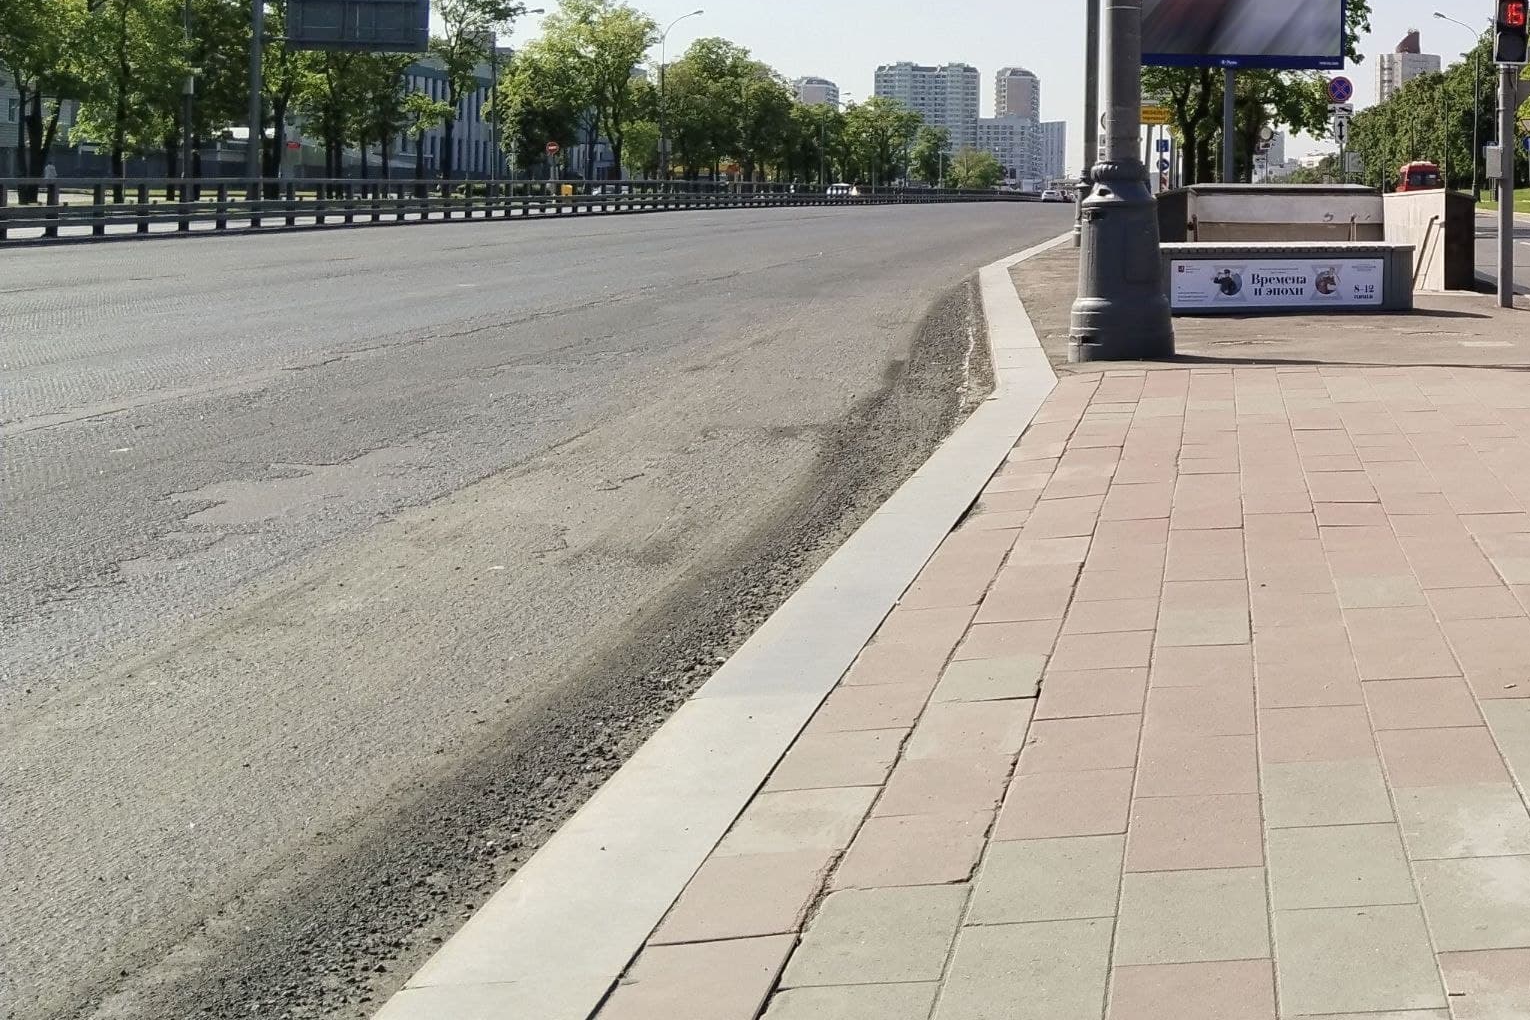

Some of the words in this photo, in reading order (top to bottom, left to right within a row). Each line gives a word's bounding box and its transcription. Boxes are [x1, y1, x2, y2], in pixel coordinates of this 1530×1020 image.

[1251, 273, 1307, 287] Времена
[1254, 288, 1262, 296] и
[1266, 287, 1304, 296] эпохи
